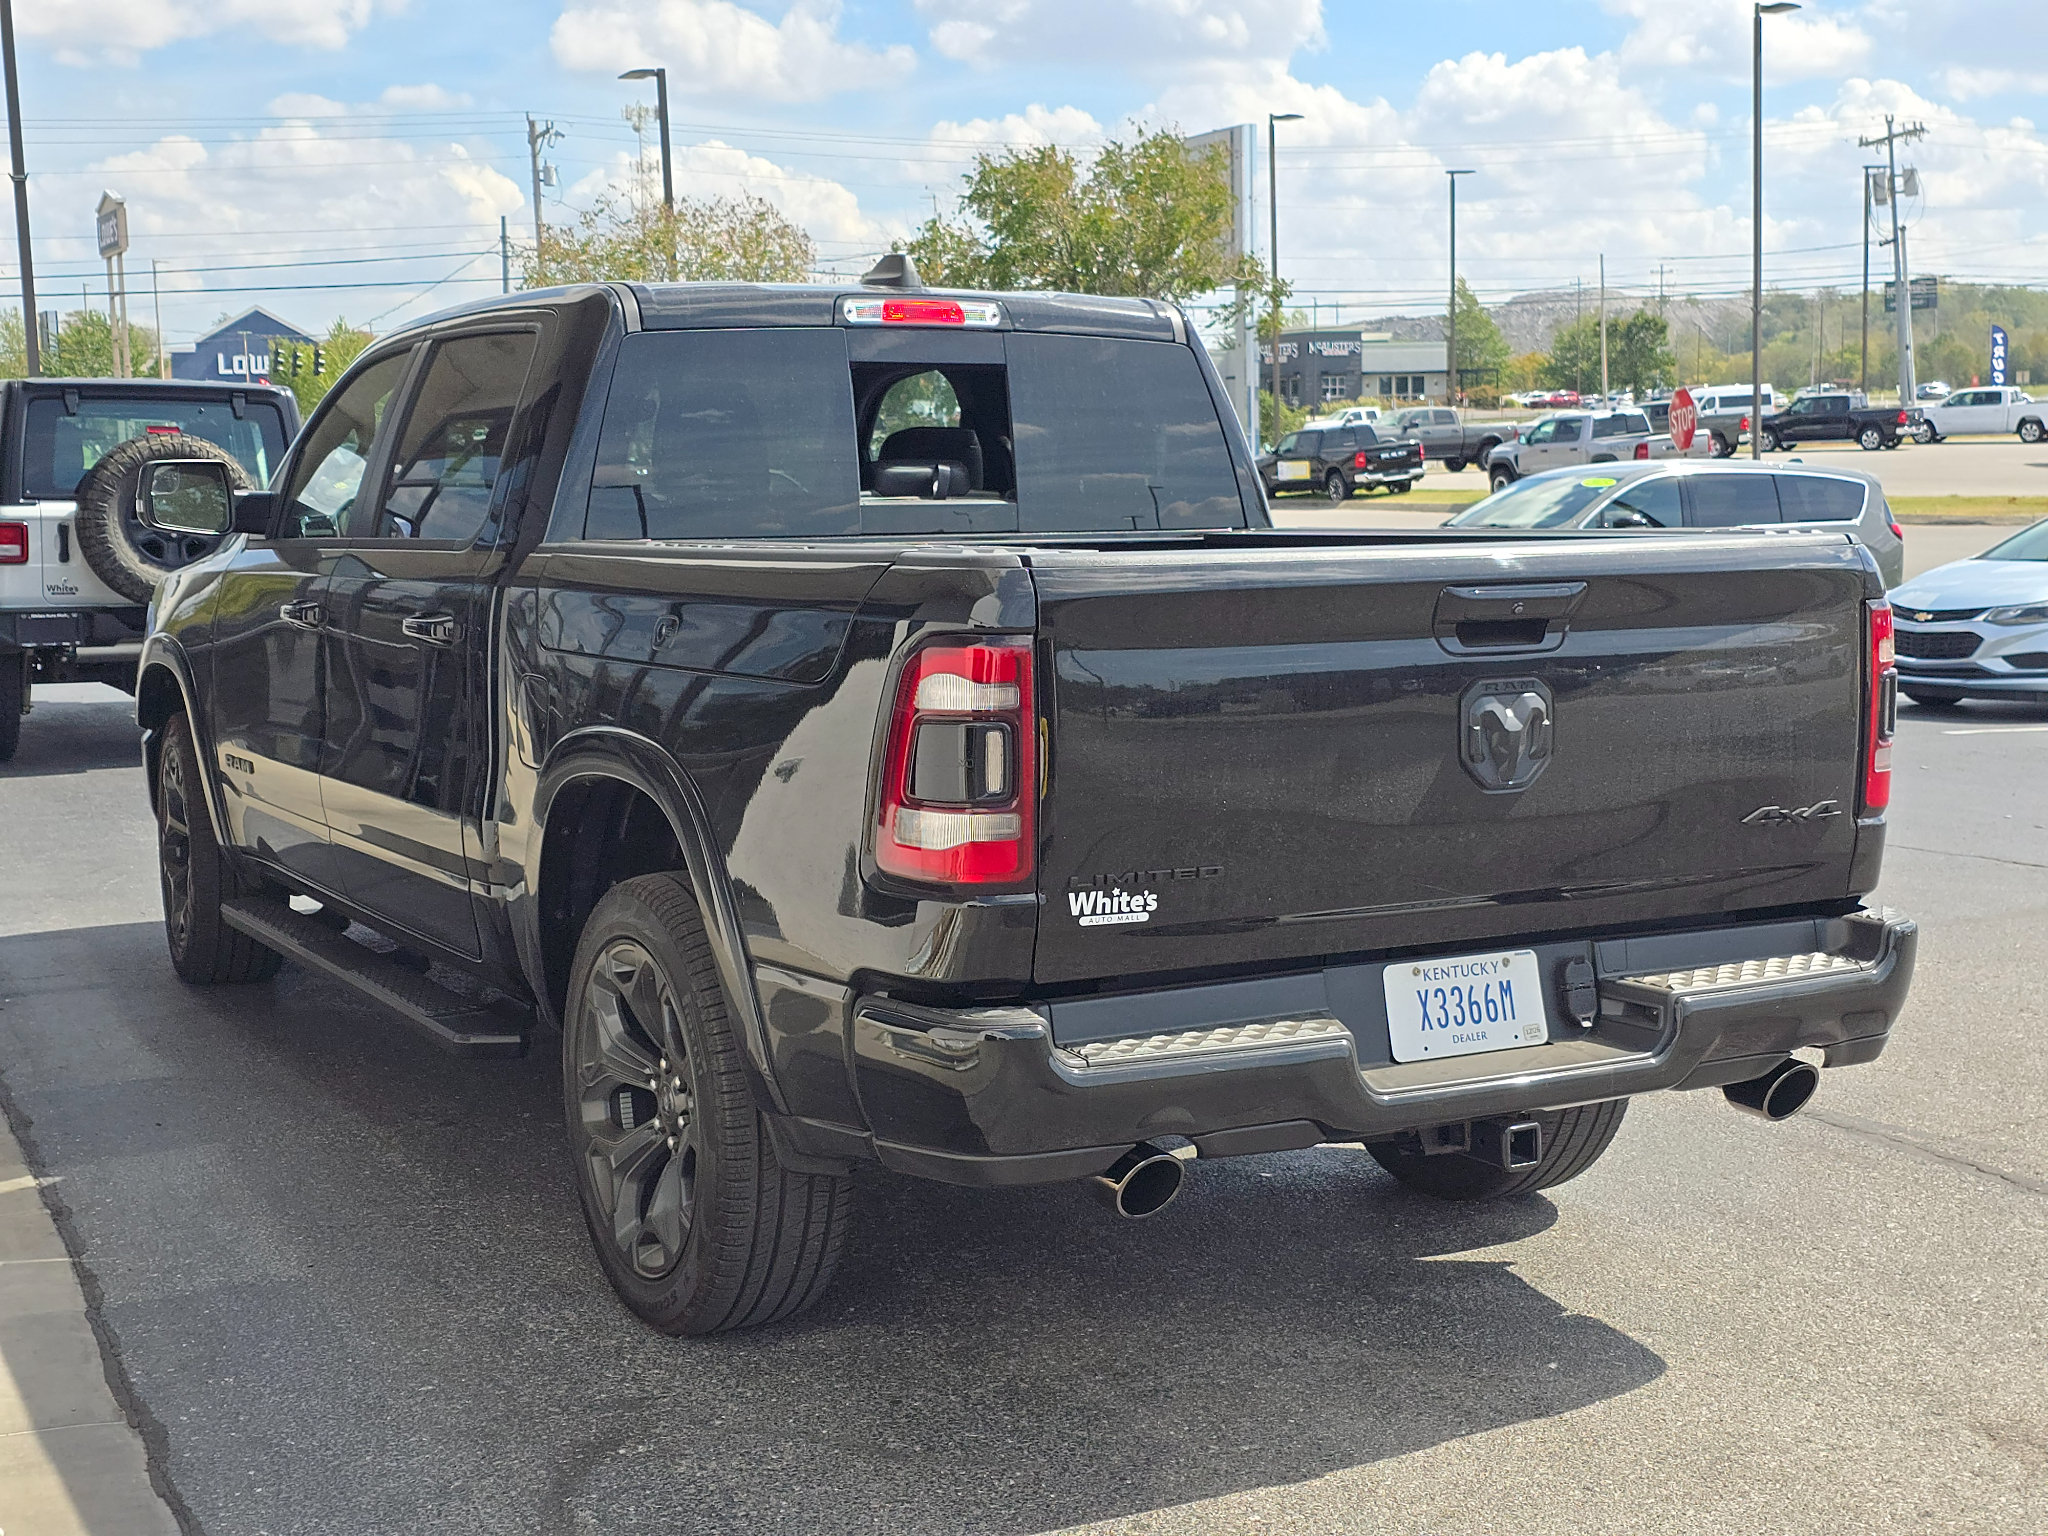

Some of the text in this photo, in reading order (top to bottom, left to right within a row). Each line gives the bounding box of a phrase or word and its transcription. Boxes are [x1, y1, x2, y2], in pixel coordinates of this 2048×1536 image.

[217, 352, 269, 375] LOW
[1992, 332, 2005, 387] TRUC
[1670, 406, 1693, 434] STOP
[46, 581, 79, 592] White's
[1484, 681, 1535, 692] RAM
[225, 754, 255, 774] RAM
[1068, 866, 1223, 888] LIMITED
[1068, 887, 1158, 916] White's
[1423, 961, 1499, 982] KENTUCKY
[1416, 979, 1516, 1032] X3366M
[1452, 1031, 1488, 1044] DEALER
